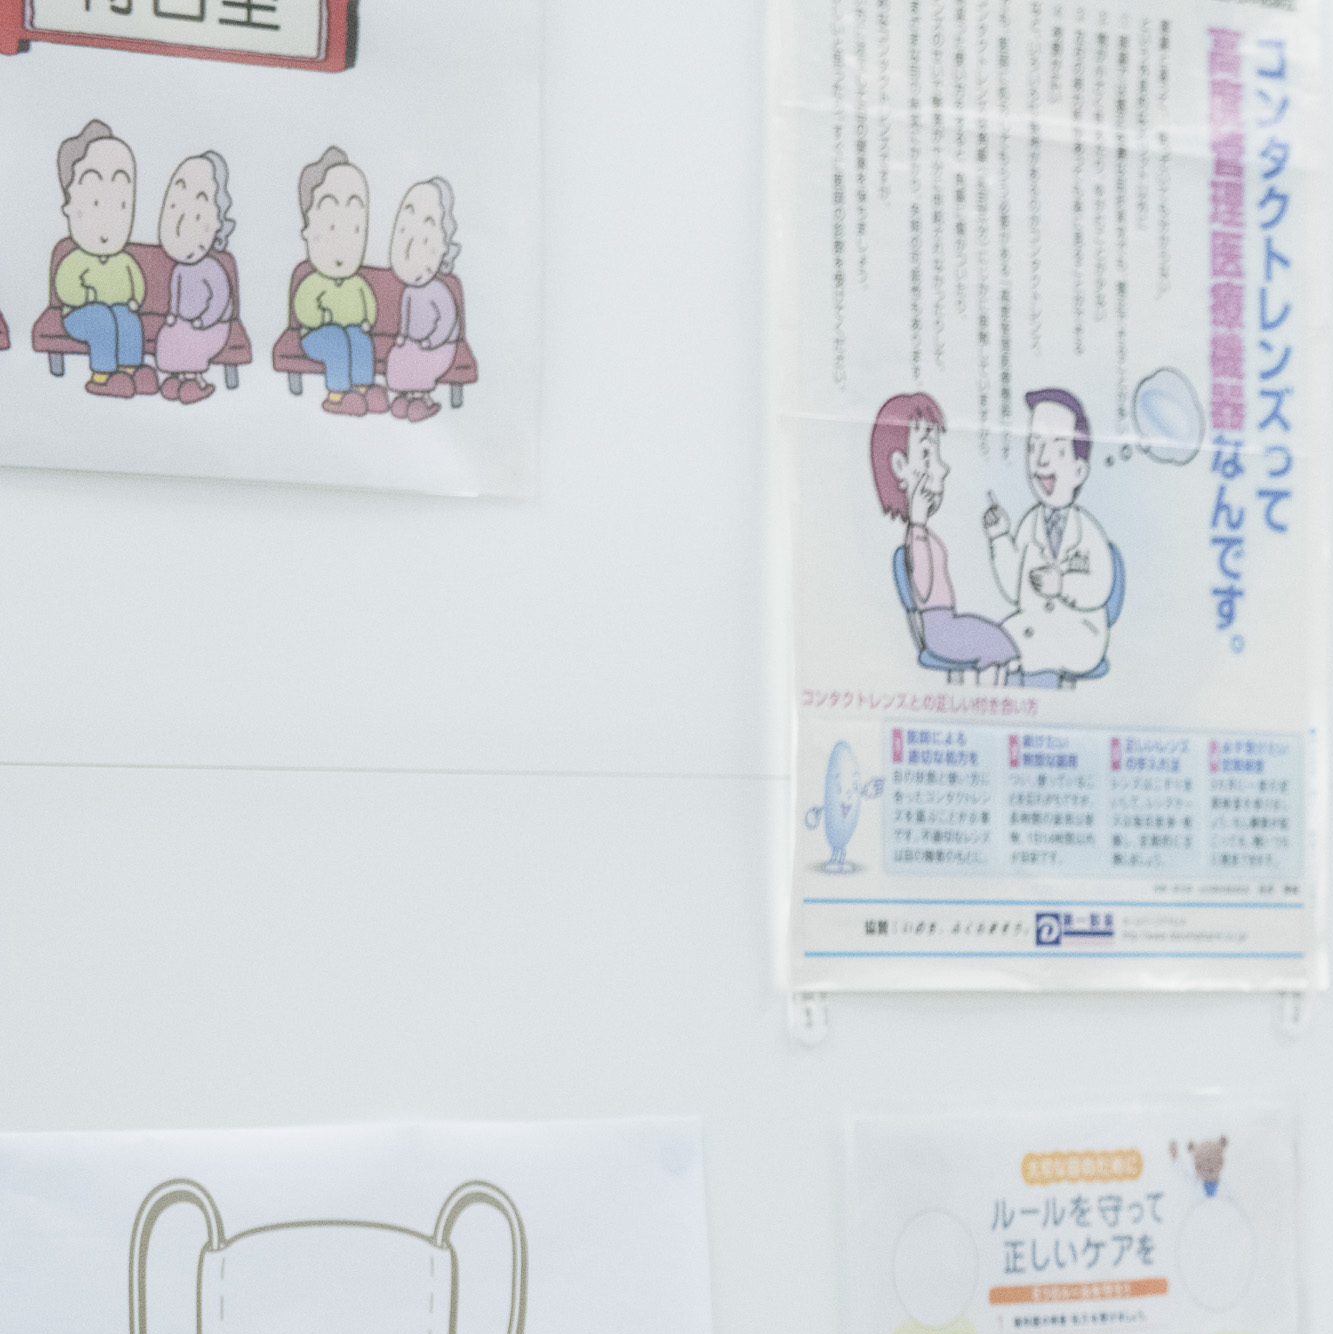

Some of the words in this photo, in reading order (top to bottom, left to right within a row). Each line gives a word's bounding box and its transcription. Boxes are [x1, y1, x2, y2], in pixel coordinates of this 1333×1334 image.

[1208, 27, 1246, 655] 高度管理医療機器なんです。
[1256, 38, 1293, 534] コンタクトレンズって
[990, 1192, 1164, 1232] ルールを守って
[1003, 1234, 1157, 1274] 正しいケアを
